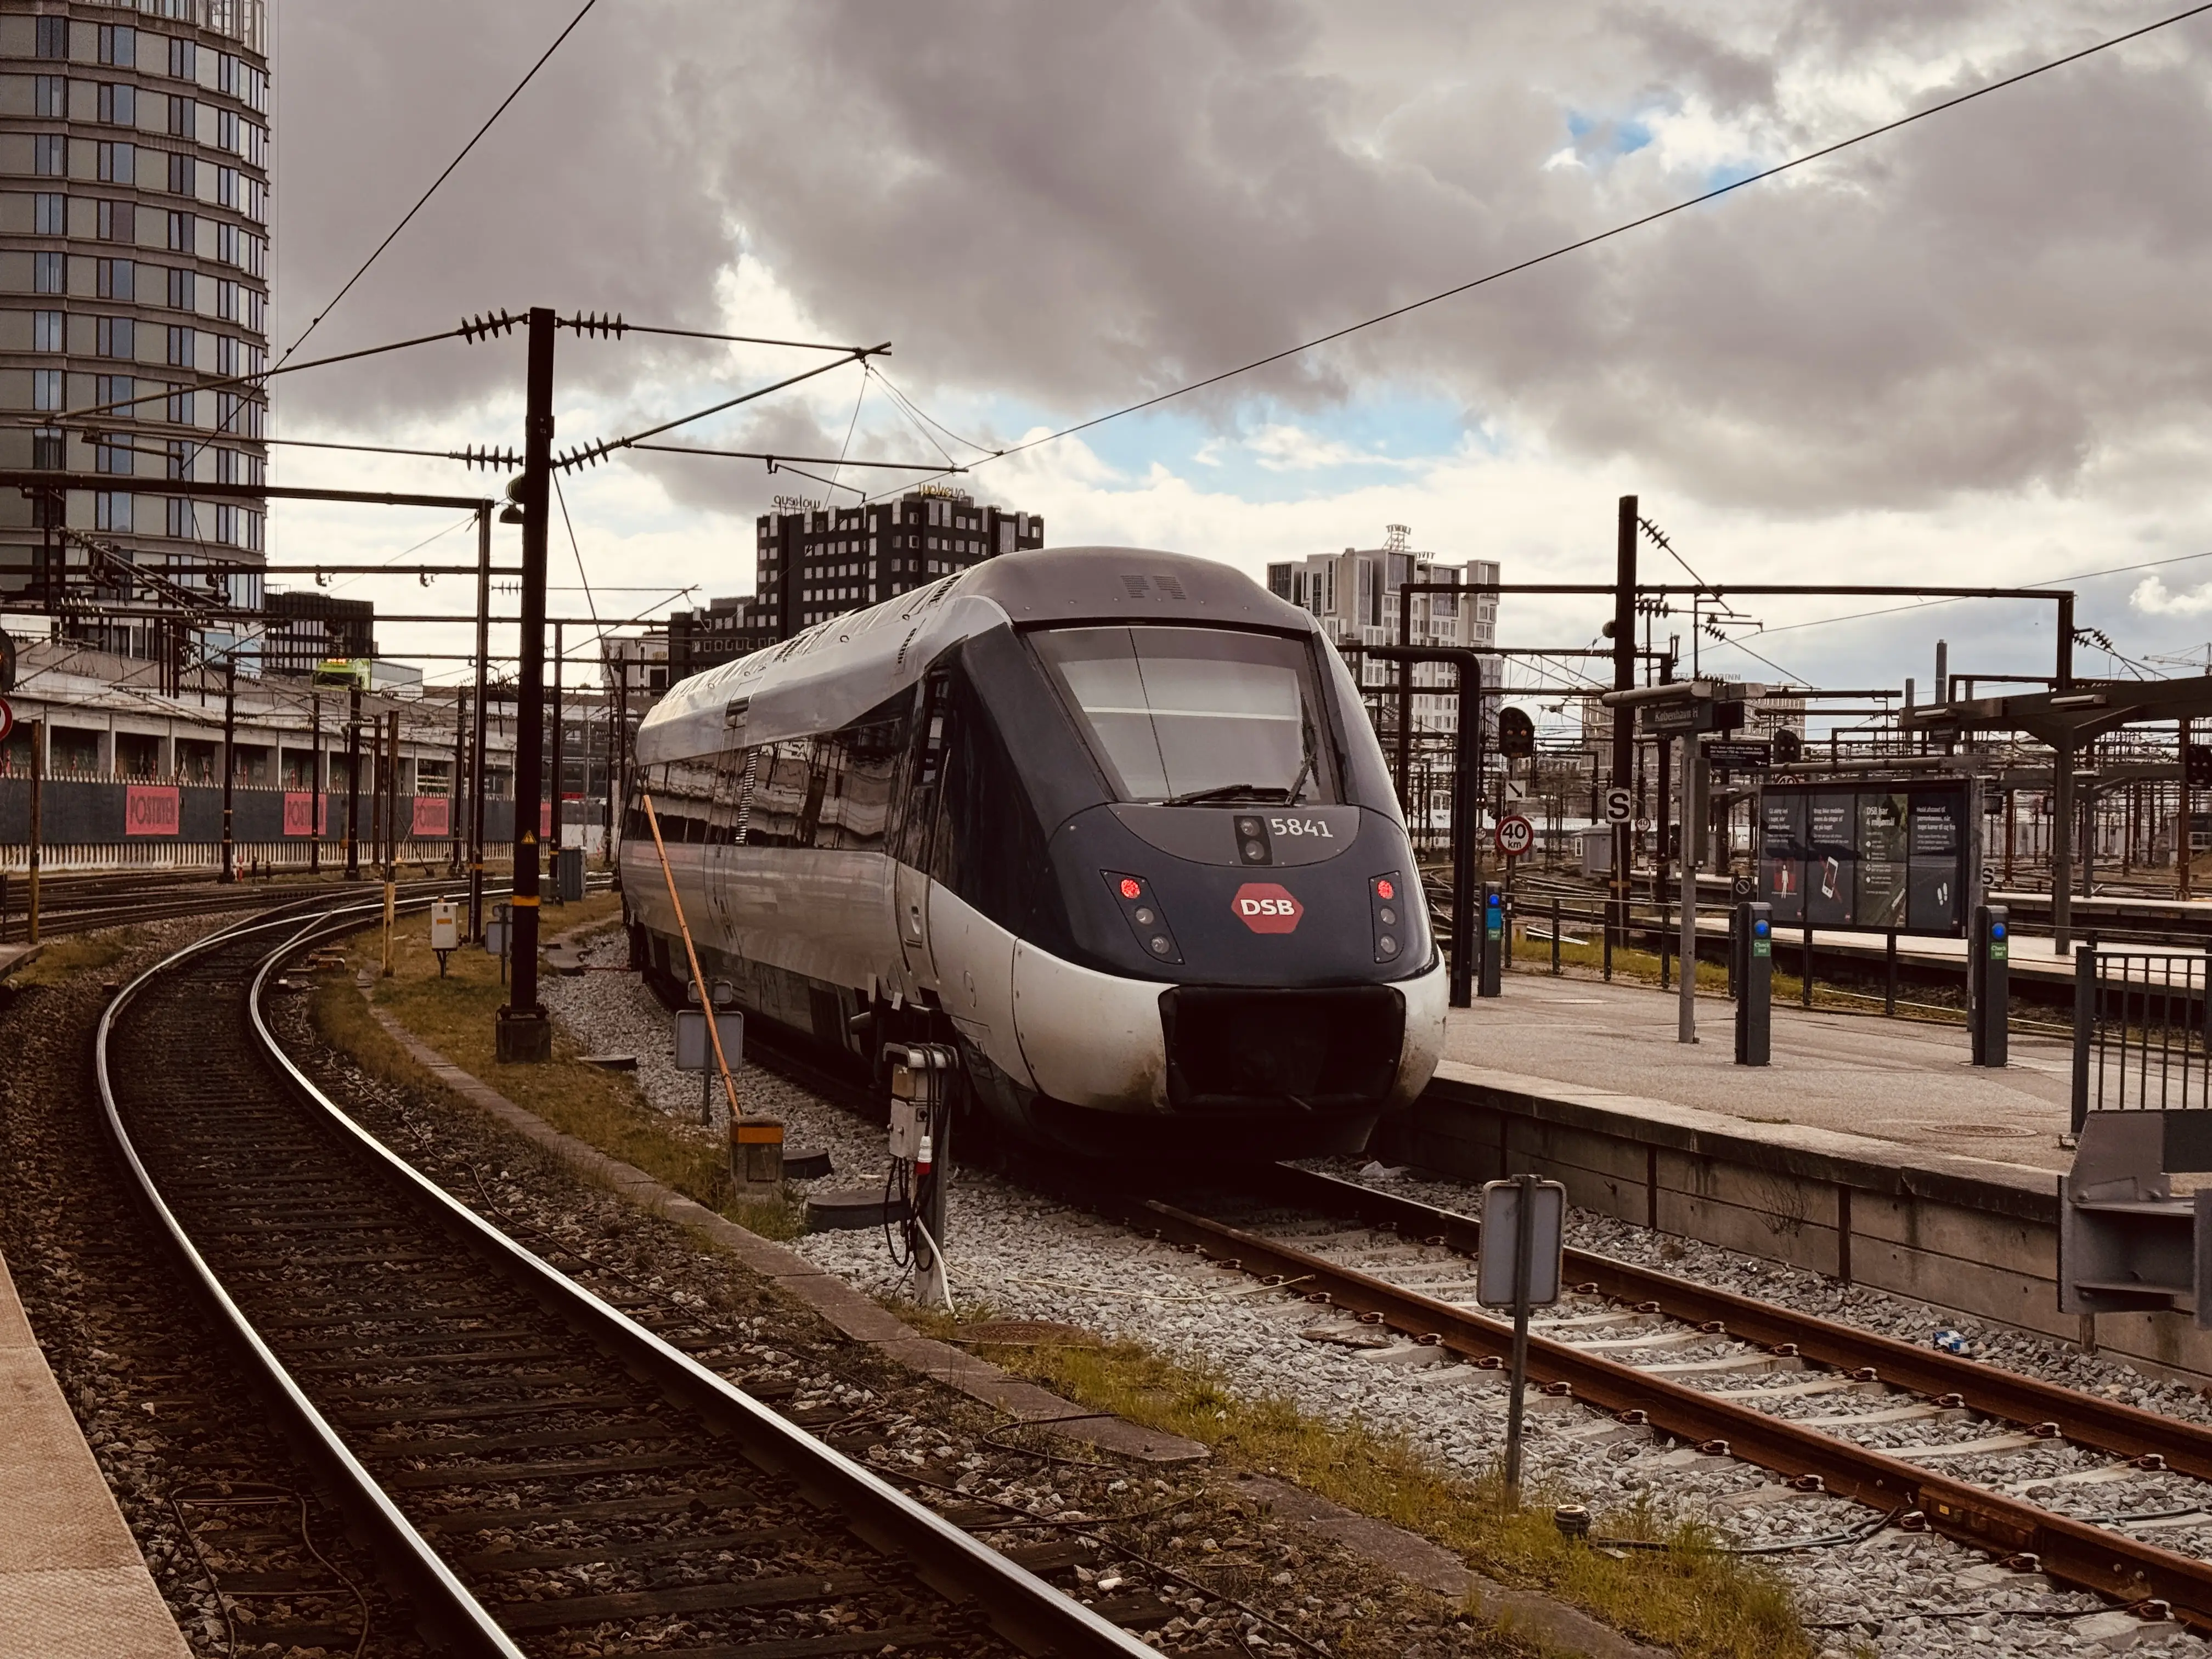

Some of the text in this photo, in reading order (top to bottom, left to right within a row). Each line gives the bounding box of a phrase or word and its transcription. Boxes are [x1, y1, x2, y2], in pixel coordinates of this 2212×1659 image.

[1608, 792, 1630, 820] S
[1866, 806, 1877, 815] DSB
[1271, 818, 1334, 838] 5841
[1502, 823, 1526, 839] 40
[1508, 840, 1522, 849] km
[1982, 867, 1994, 885] S
[1240, 899, 1295, 916] DSB
